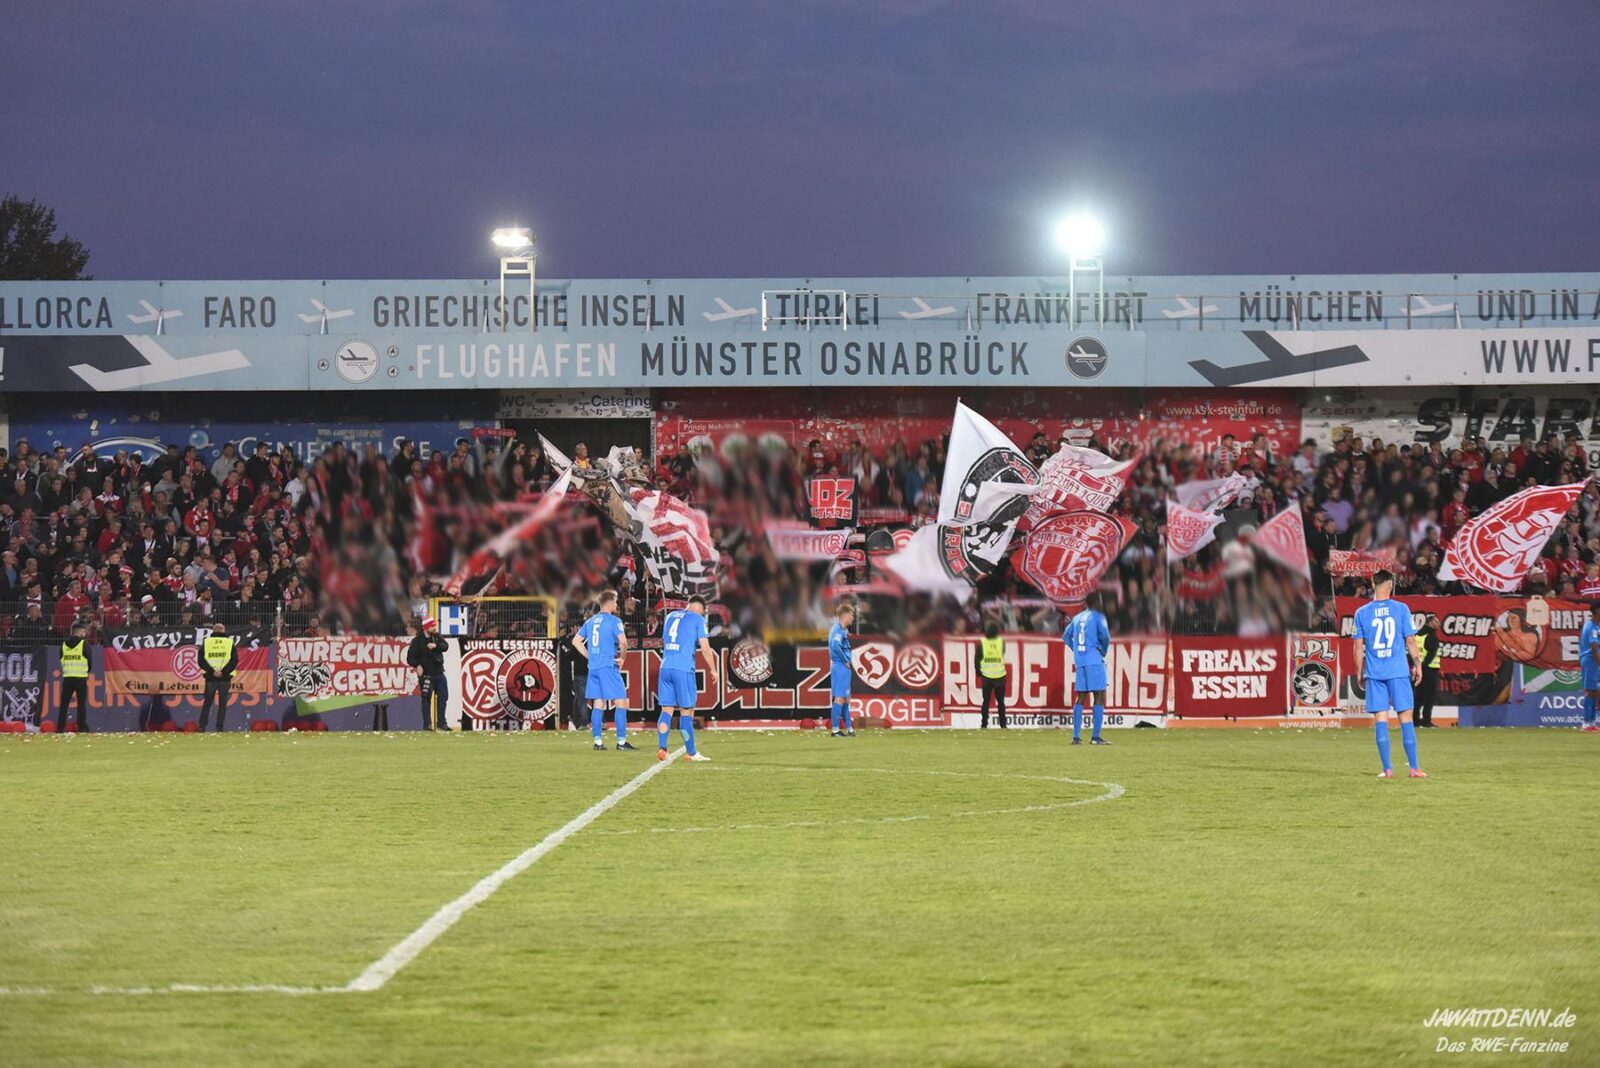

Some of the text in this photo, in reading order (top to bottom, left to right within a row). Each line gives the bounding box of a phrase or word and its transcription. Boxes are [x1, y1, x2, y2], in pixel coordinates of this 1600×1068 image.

[204, 296, 276, 327] FARO
[373, 295, 684, 327] GRIECHISCHE INSELN
[776, 288, 878, 325] TÜRKEI
[977, 292, 1147, 324] FRANKFURT
[1239, 285, 1382, 322] MÜNCHEN
[1478, 289, 1535, 321] UND
[1551, 289, 1579, 320] IN
[416, 335, 1029, 379] FLUGHAFEN MÜNSTER OSNABRÜCK
[501, 394, 651, 410] WC Catering
[1414, 397, 1600, 443] STAR
[441, 606, 467, 635] H
[668, 618, 680, 643] 4
[1371, 616, 1395, 650] 29
[464, 640, 554, 650] JUNGE ESSENER
[1181, 648, 1278, 673] FREAKS
[1292, 638, 1337, 661] LPL
[333, 667, 402, 692] CREW
[1192, 675, 1268, 700] ESSEN
